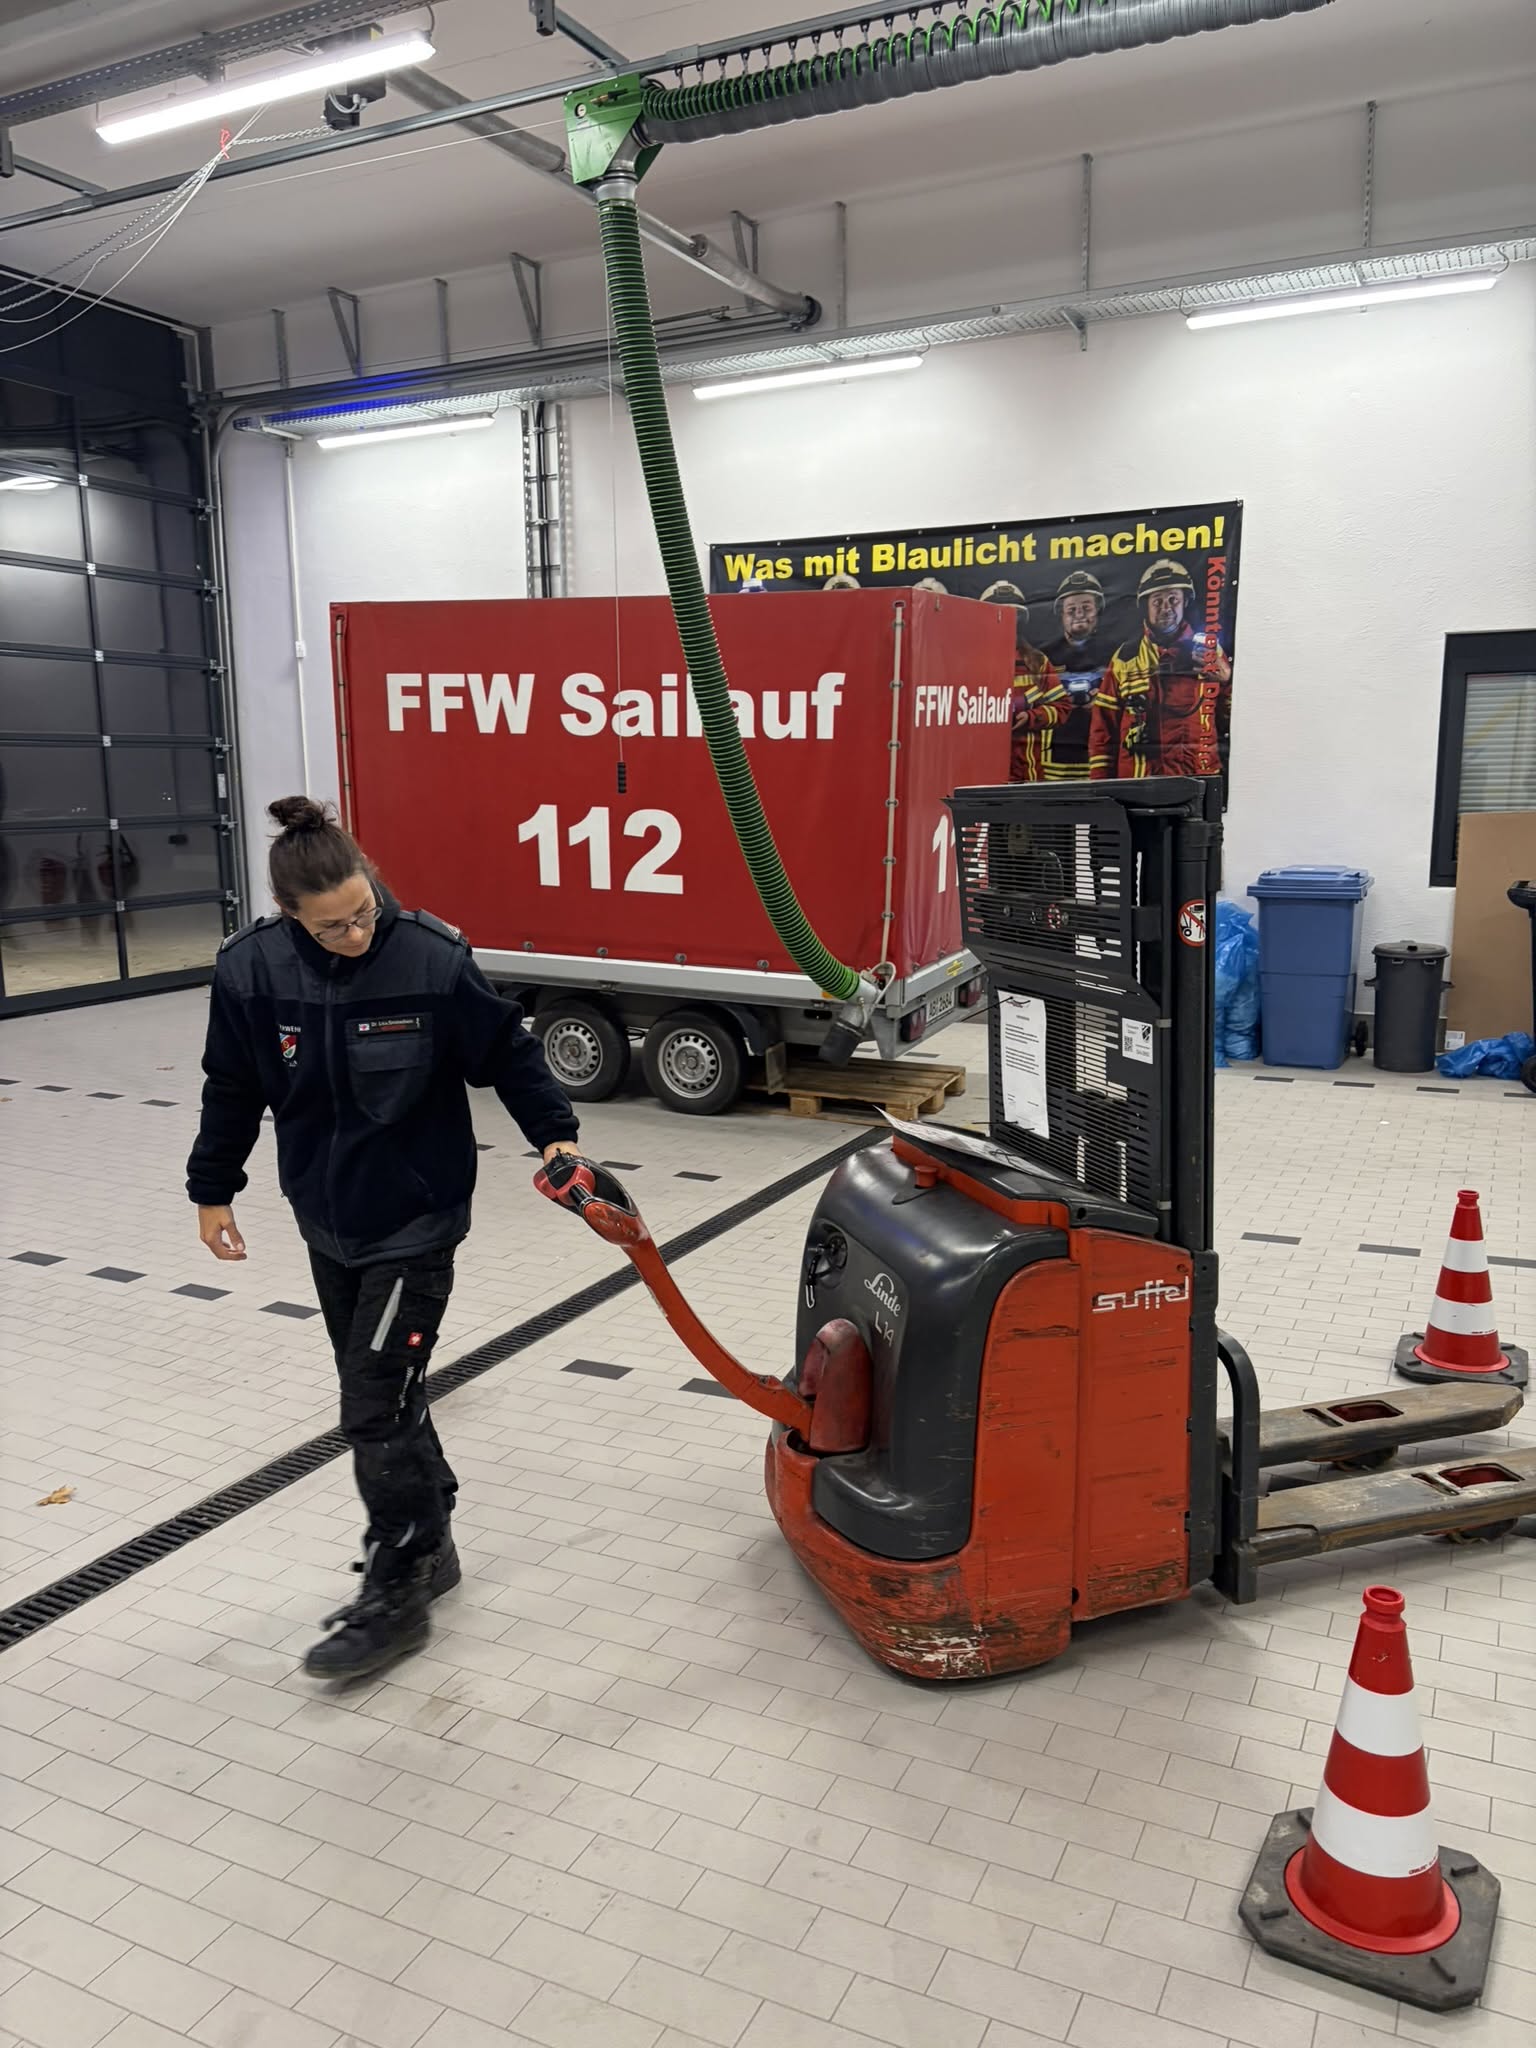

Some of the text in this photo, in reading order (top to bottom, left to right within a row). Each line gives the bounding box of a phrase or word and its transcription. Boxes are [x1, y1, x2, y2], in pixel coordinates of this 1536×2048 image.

[724, 515, 1225, 582] Was mit Blaulicht machen!
[386, 671, 847, 740] FFW Sailauf
[915, 684, 1013, 728] FFW Sailauf
[518, 803, 684, 895] 112
[863, 1272, 902, 1317] Linde
[1092, 1275, 1190, 1313] suffel
